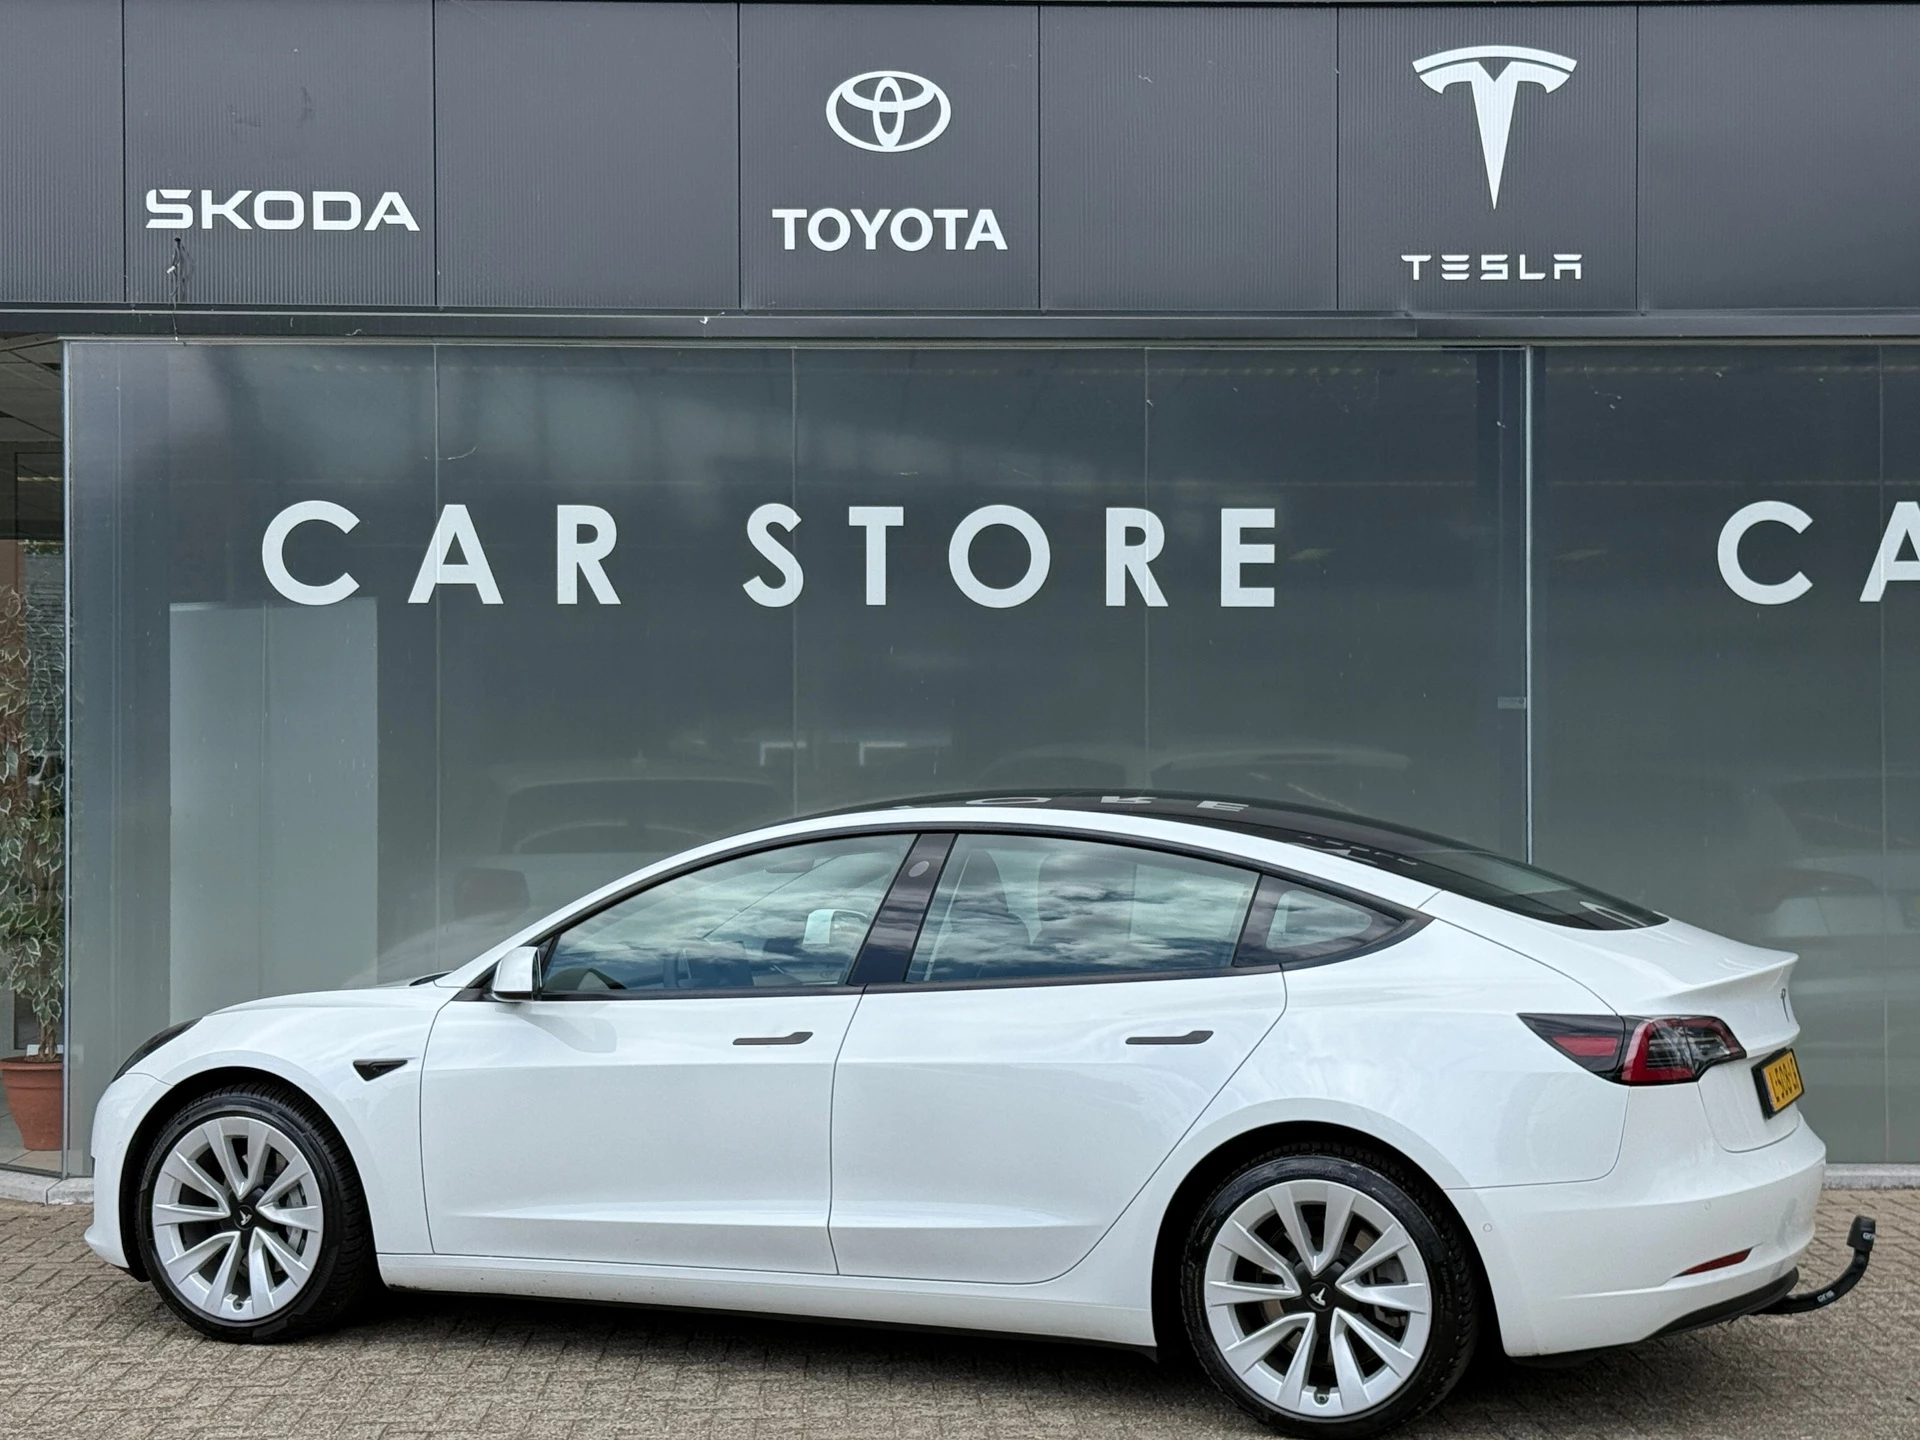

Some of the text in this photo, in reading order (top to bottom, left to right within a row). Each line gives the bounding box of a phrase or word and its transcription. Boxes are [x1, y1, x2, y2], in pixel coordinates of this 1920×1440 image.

[145, 189, 421, 232] SKODA
[772, 207, 1008, 252] TOYOTA
[1401, 253, 1583, 281] TESLA
[262, 500, 1276, 609] CAR STORE
